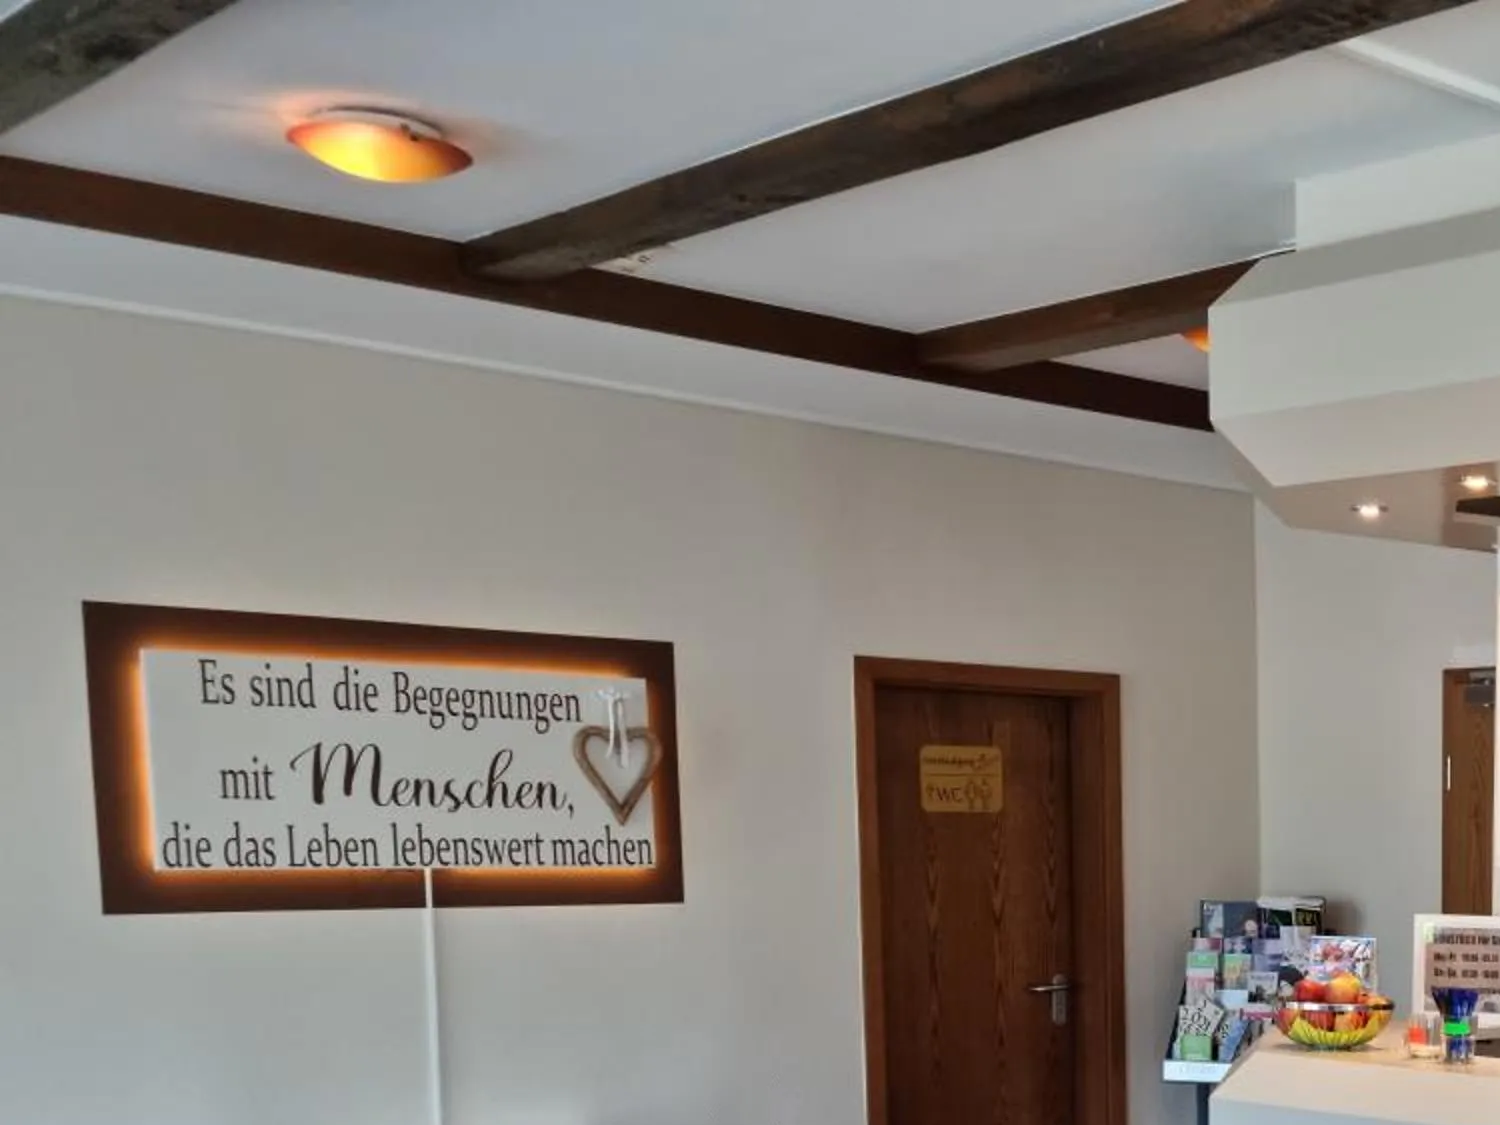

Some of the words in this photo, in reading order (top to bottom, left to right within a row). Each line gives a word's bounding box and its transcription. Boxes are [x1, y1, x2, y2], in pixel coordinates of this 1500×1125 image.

[198, 658, 236, 706] Es
[249, 663, 317, 710] sind
[332, 666, 379, 714] die
[392, 671, 583, 733] Begegnungen
[219, 756, 274, 802] mit
[289, 741, 576, 818] Menschen,
[162, 822, 212, 869] die
[223, 822, 277, 869] das
[286, 823, 380, 869] Leben
[391, 823, 545, 868] lebenswert
[551, 825, 654, 867] machen
